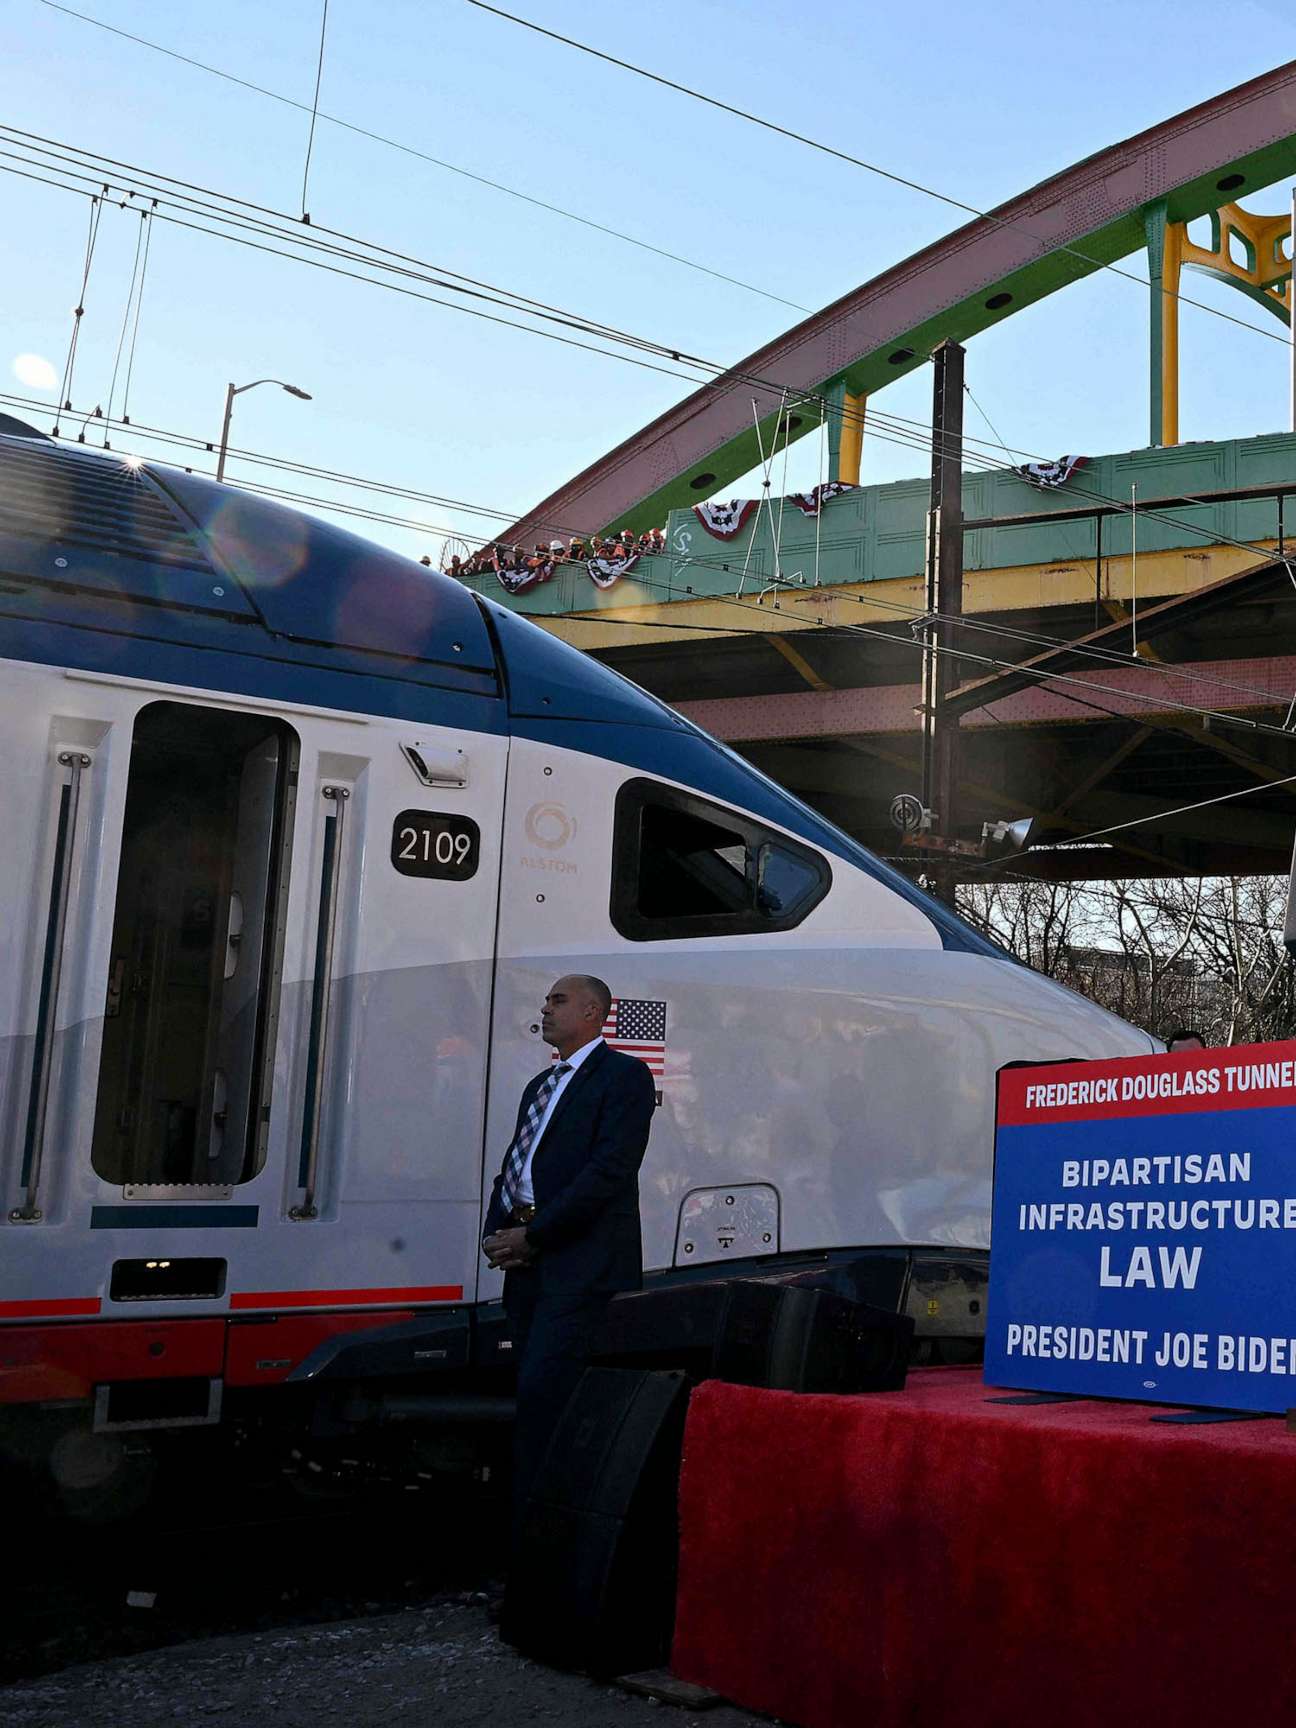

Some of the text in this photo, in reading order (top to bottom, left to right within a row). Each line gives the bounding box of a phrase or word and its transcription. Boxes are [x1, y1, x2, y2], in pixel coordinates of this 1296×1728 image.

[399, 828, 470, 864] 2109
[1026, 1079, 1118, 1108] FREDERICK
[1122, 1068, 1220, 1100] DOUGLASS
[1063, 1153, 1250, 1187] BIPARTISAN
[1100, 1247, 1202, 1288] LAW
[1008, 1325, 1147, 1363] PRESIDENT
[1156, 1333, 1208, 1368] JOE
